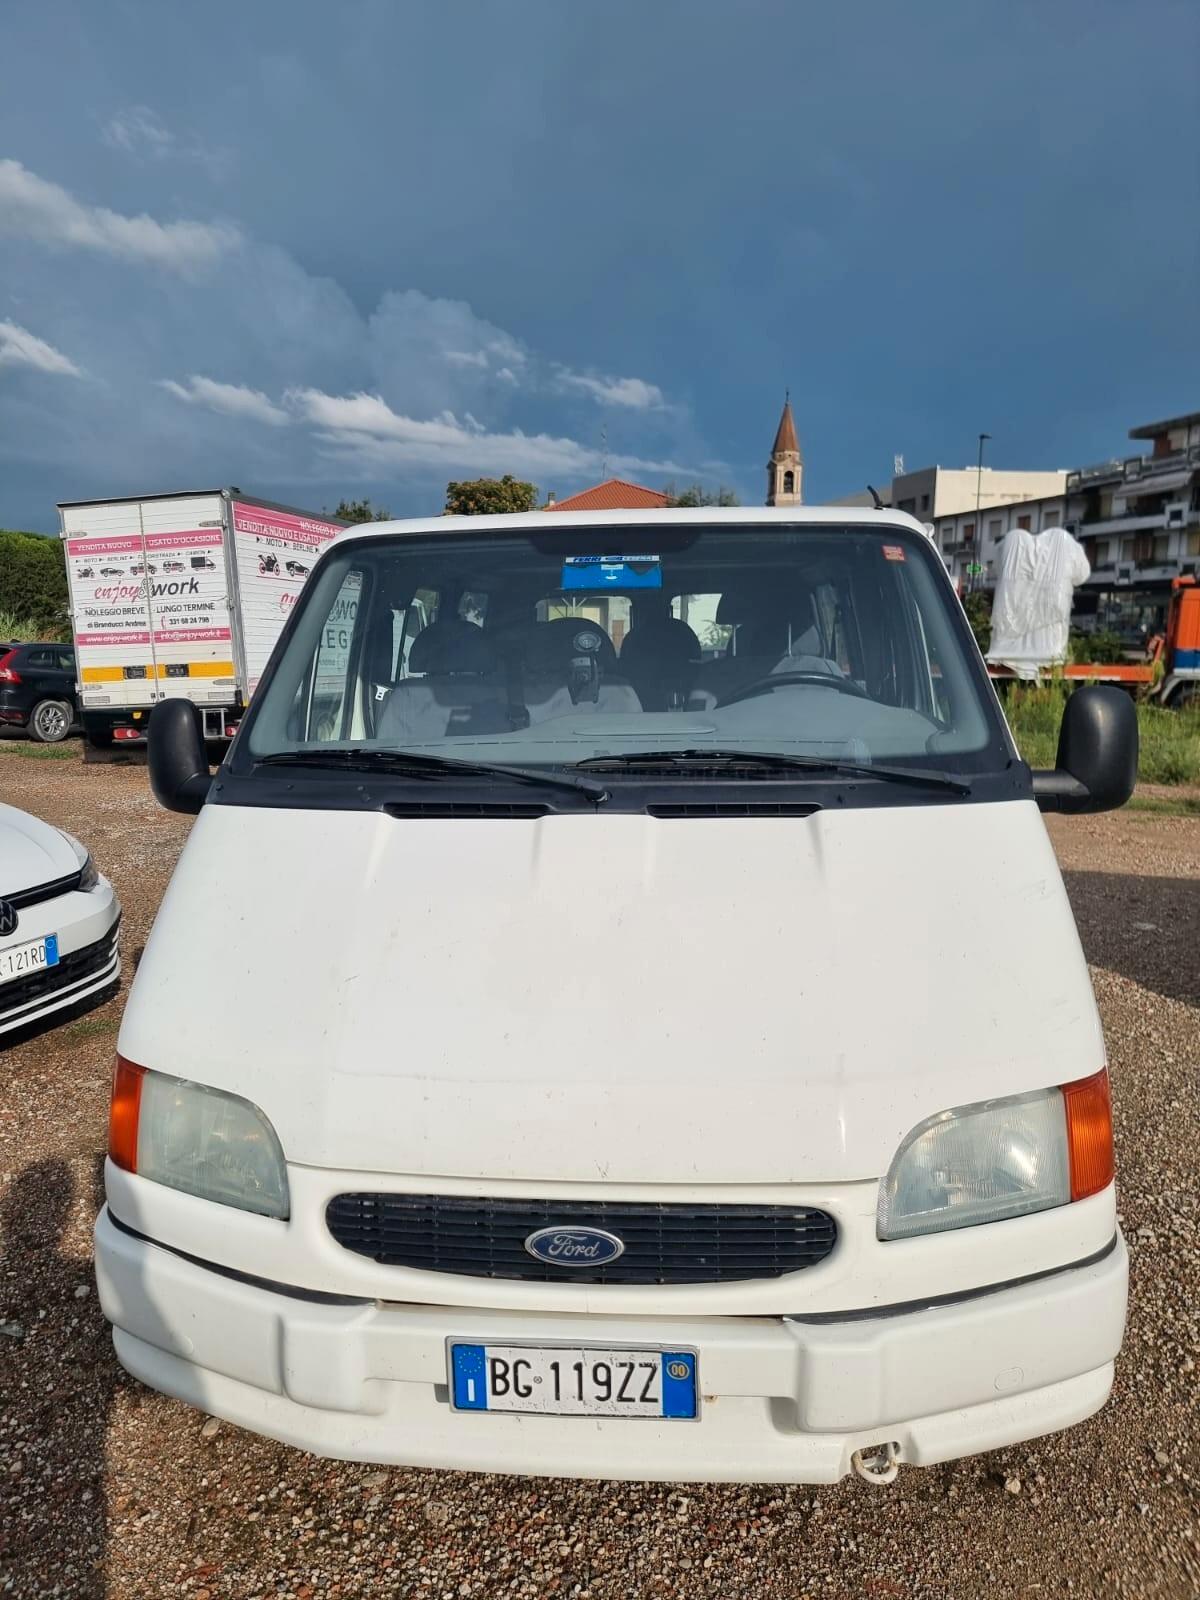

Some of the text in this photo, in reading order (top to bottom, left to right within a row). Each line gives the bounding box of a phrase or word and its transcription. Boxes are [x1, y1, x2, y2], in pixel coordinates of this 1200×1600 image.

[238, 520, 269, 534] VENDITA
[269, 525, 294, 538] NUOVO
[77, 543, 107, 551] VENDITA
[107, 541, 132, 549] NUOVO
[149, 538, 172, 546] USATO
[266, 538, 283, 547] MOTO
[94, 580, 141, 605] enjoy
[152, 577, 200, 597] work
[85, 607, 121, 616] NOLEGGIO
[122, 606, 146, 615] BREVE
[156, 604, 183, 614] LUNGO
[183, 602, 216, 613] TERMINE
[548, 1234, 600, 1258] Ford
[489, 1357, 533, 1398] BG
[550, 1361, 659, 1403] 119ZZ
